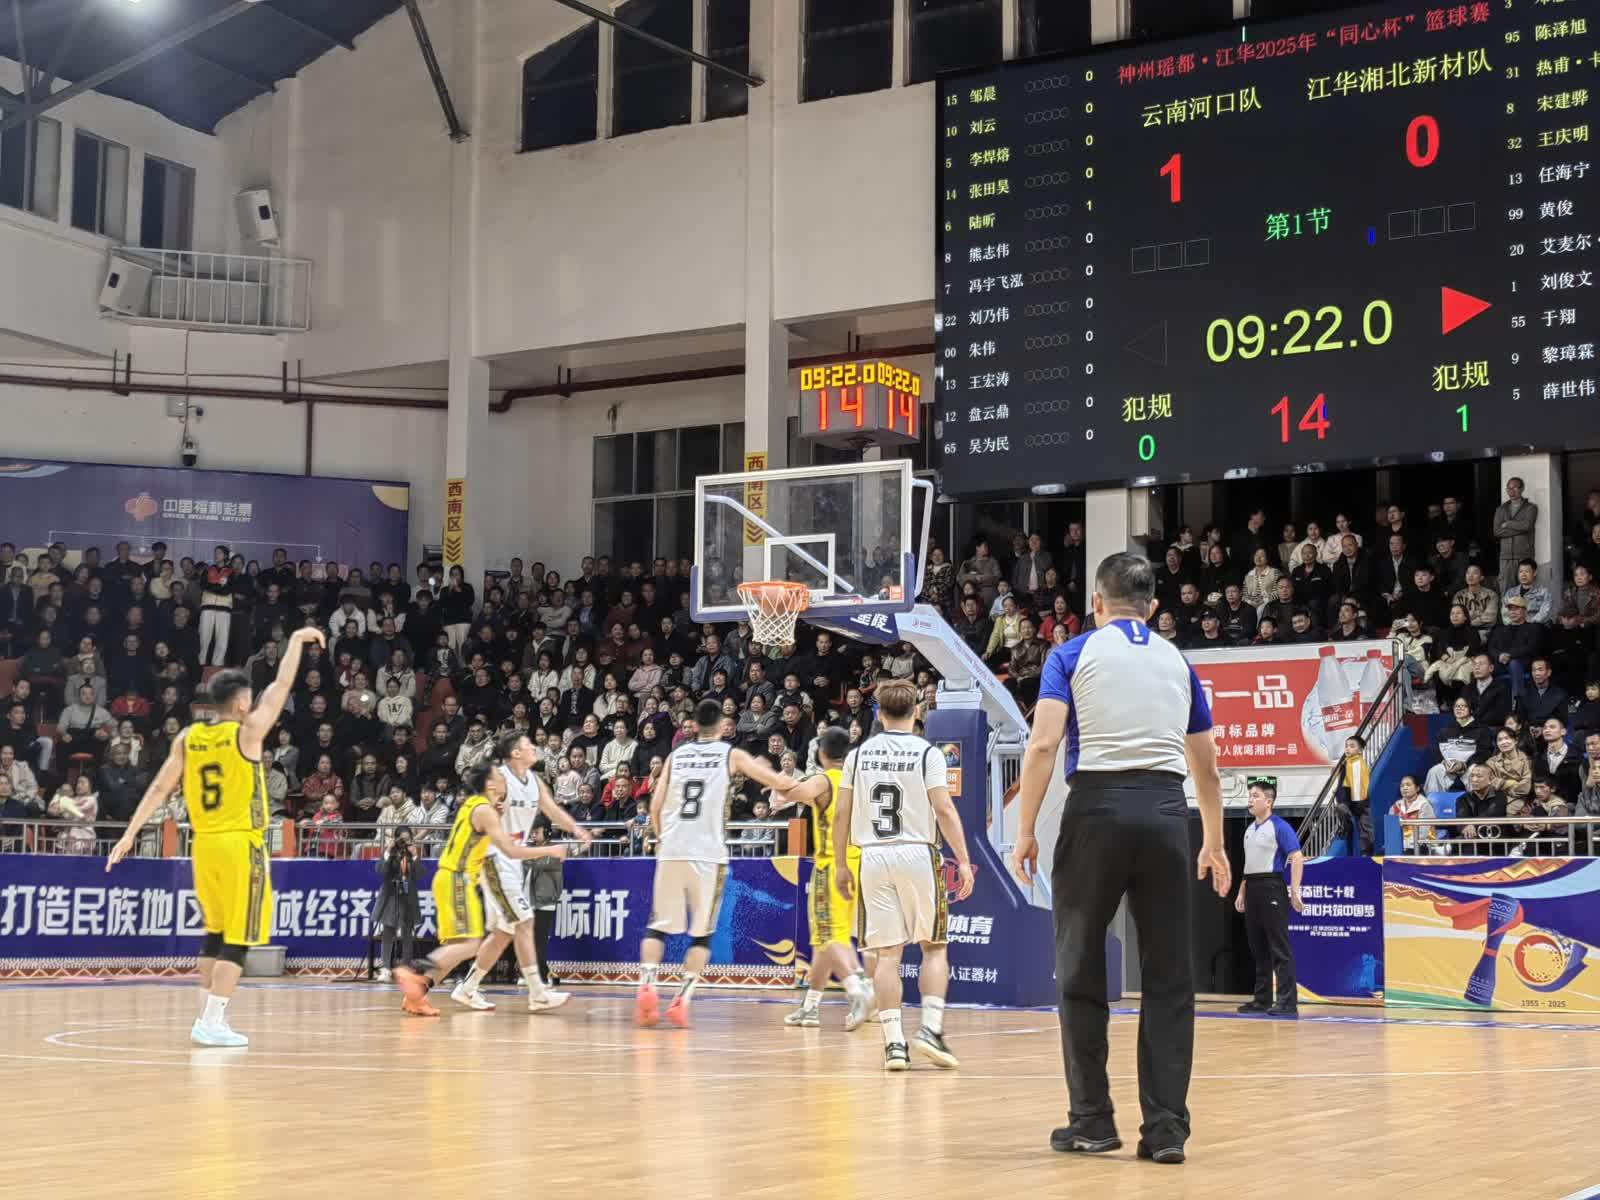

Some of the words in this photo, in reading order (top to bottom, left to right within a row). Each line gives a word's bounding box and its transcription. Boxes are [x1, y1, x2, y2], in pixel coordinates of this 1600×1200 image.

[1535, 18, 1587, 42] 陈泽旭
[1504, 31, 1520, 43] 95
[1085, 70, 1094, 81] 0
[1307, 48, 1492, 101] 江华湘北新材队
[1506, 66, 1520, 79] 31
[946, 95, 958, 106] 15
[969, 86, 997, 104] 邹晨
[1085, 102, 1094, 113] 0
[1141, 86, 1263, 128] 云南河口队
[1506, 103, 1514, 114] 8
[945, 126, 957, 137] 10
[969, 119, 997, 135] 刘云
[1085, 135, 1094, 146] 0
[1404, 115, 1441, 168] 0
[1537, 125, 1589, 148] 王庆明
[1507, 138, 1522, 150] 32
[945, 158, 952, 169] 5
[1085, 167, 1094, 178] 0
[1159, 153, 1183, 204] 1
[1538, 161, 1590, 184] 任海宁
[1509, 173, 1523, 186] 13
[945, 189, 957, 201] 14
[1085, 200, 1093, 211] 1
[1539, 199, 1574, 220] 黄俊
[1508, 208, 1524, 221] 99
[945, 222, 952, 232] 6
[1264, 207, 1332, 241] 第1节
[1085, 232, 1094, 243] 0
[969, 243, 1010, 263] 熊志伟
[1509, 244, 1525, 257] 20
[945, 253, 952, 264] 8
[1085, 265, 1094, 276] 0
[969, 273, 1024, 294] 冯宇飞泓
[1511, 281, 1517, 292] 1
[1540, 270, 1593, 291] 刘俊文
[945, 284, 951, 295] 7
[1085, 298, 1094, 309] 0
[944, 315, 957, 327] 22
[968, 306, 1010, 325] 刘乃伟
[1511, 316, 1526, 328] 55
[1541, 308, 1576, 327] 于翔
[1085, 330, 1094, 341] 0
[1206, 299, 1394, 363] 09:22.0
[944, 347, 957, 358] 00
[968, 340, 996, 358] 朱伟
[1511, 353, 1520, 365] 9
[1085, 363, 1094, 374] 0
[800, 363, 875, 391] 09:22.0
[877, 362, 920, 396] 09:22.0
[968, 371, 1010, 390] 王宏涛
[1432, 360, 1491, 392] 犯规
[945, 379, 957, 390] 13
[1543, 379, 1596, 400] 薛世伟
[1512, 388, 1520, 401] 5
[818, 385, 865, 431] 14
[1085, 396, 1094, 408] 0
[1122, 393, 1173, 422] 犯规
[886, 389, 914, 436] 14
[945, 412, 957, 423] 12
[968, 404, 1010, 423] 盘云鼎
[1270, 393, 1331, 443] 14
[1456, 404, 1469, 433] 1
[1085, 429, 1094, 440] 0
[944, 443, 957, 454] 65
[968, 436, 1010, 455] 吴为民
[1137, 434, 1156, 461] 0
[447, 482, 463, 532] 西南区
[200, 762, 222, 812] 6
[681, 779, 704, 819] 8
[870, 782, 904, 840] 3
[1548, 1000, 1566, 1008] 2025
